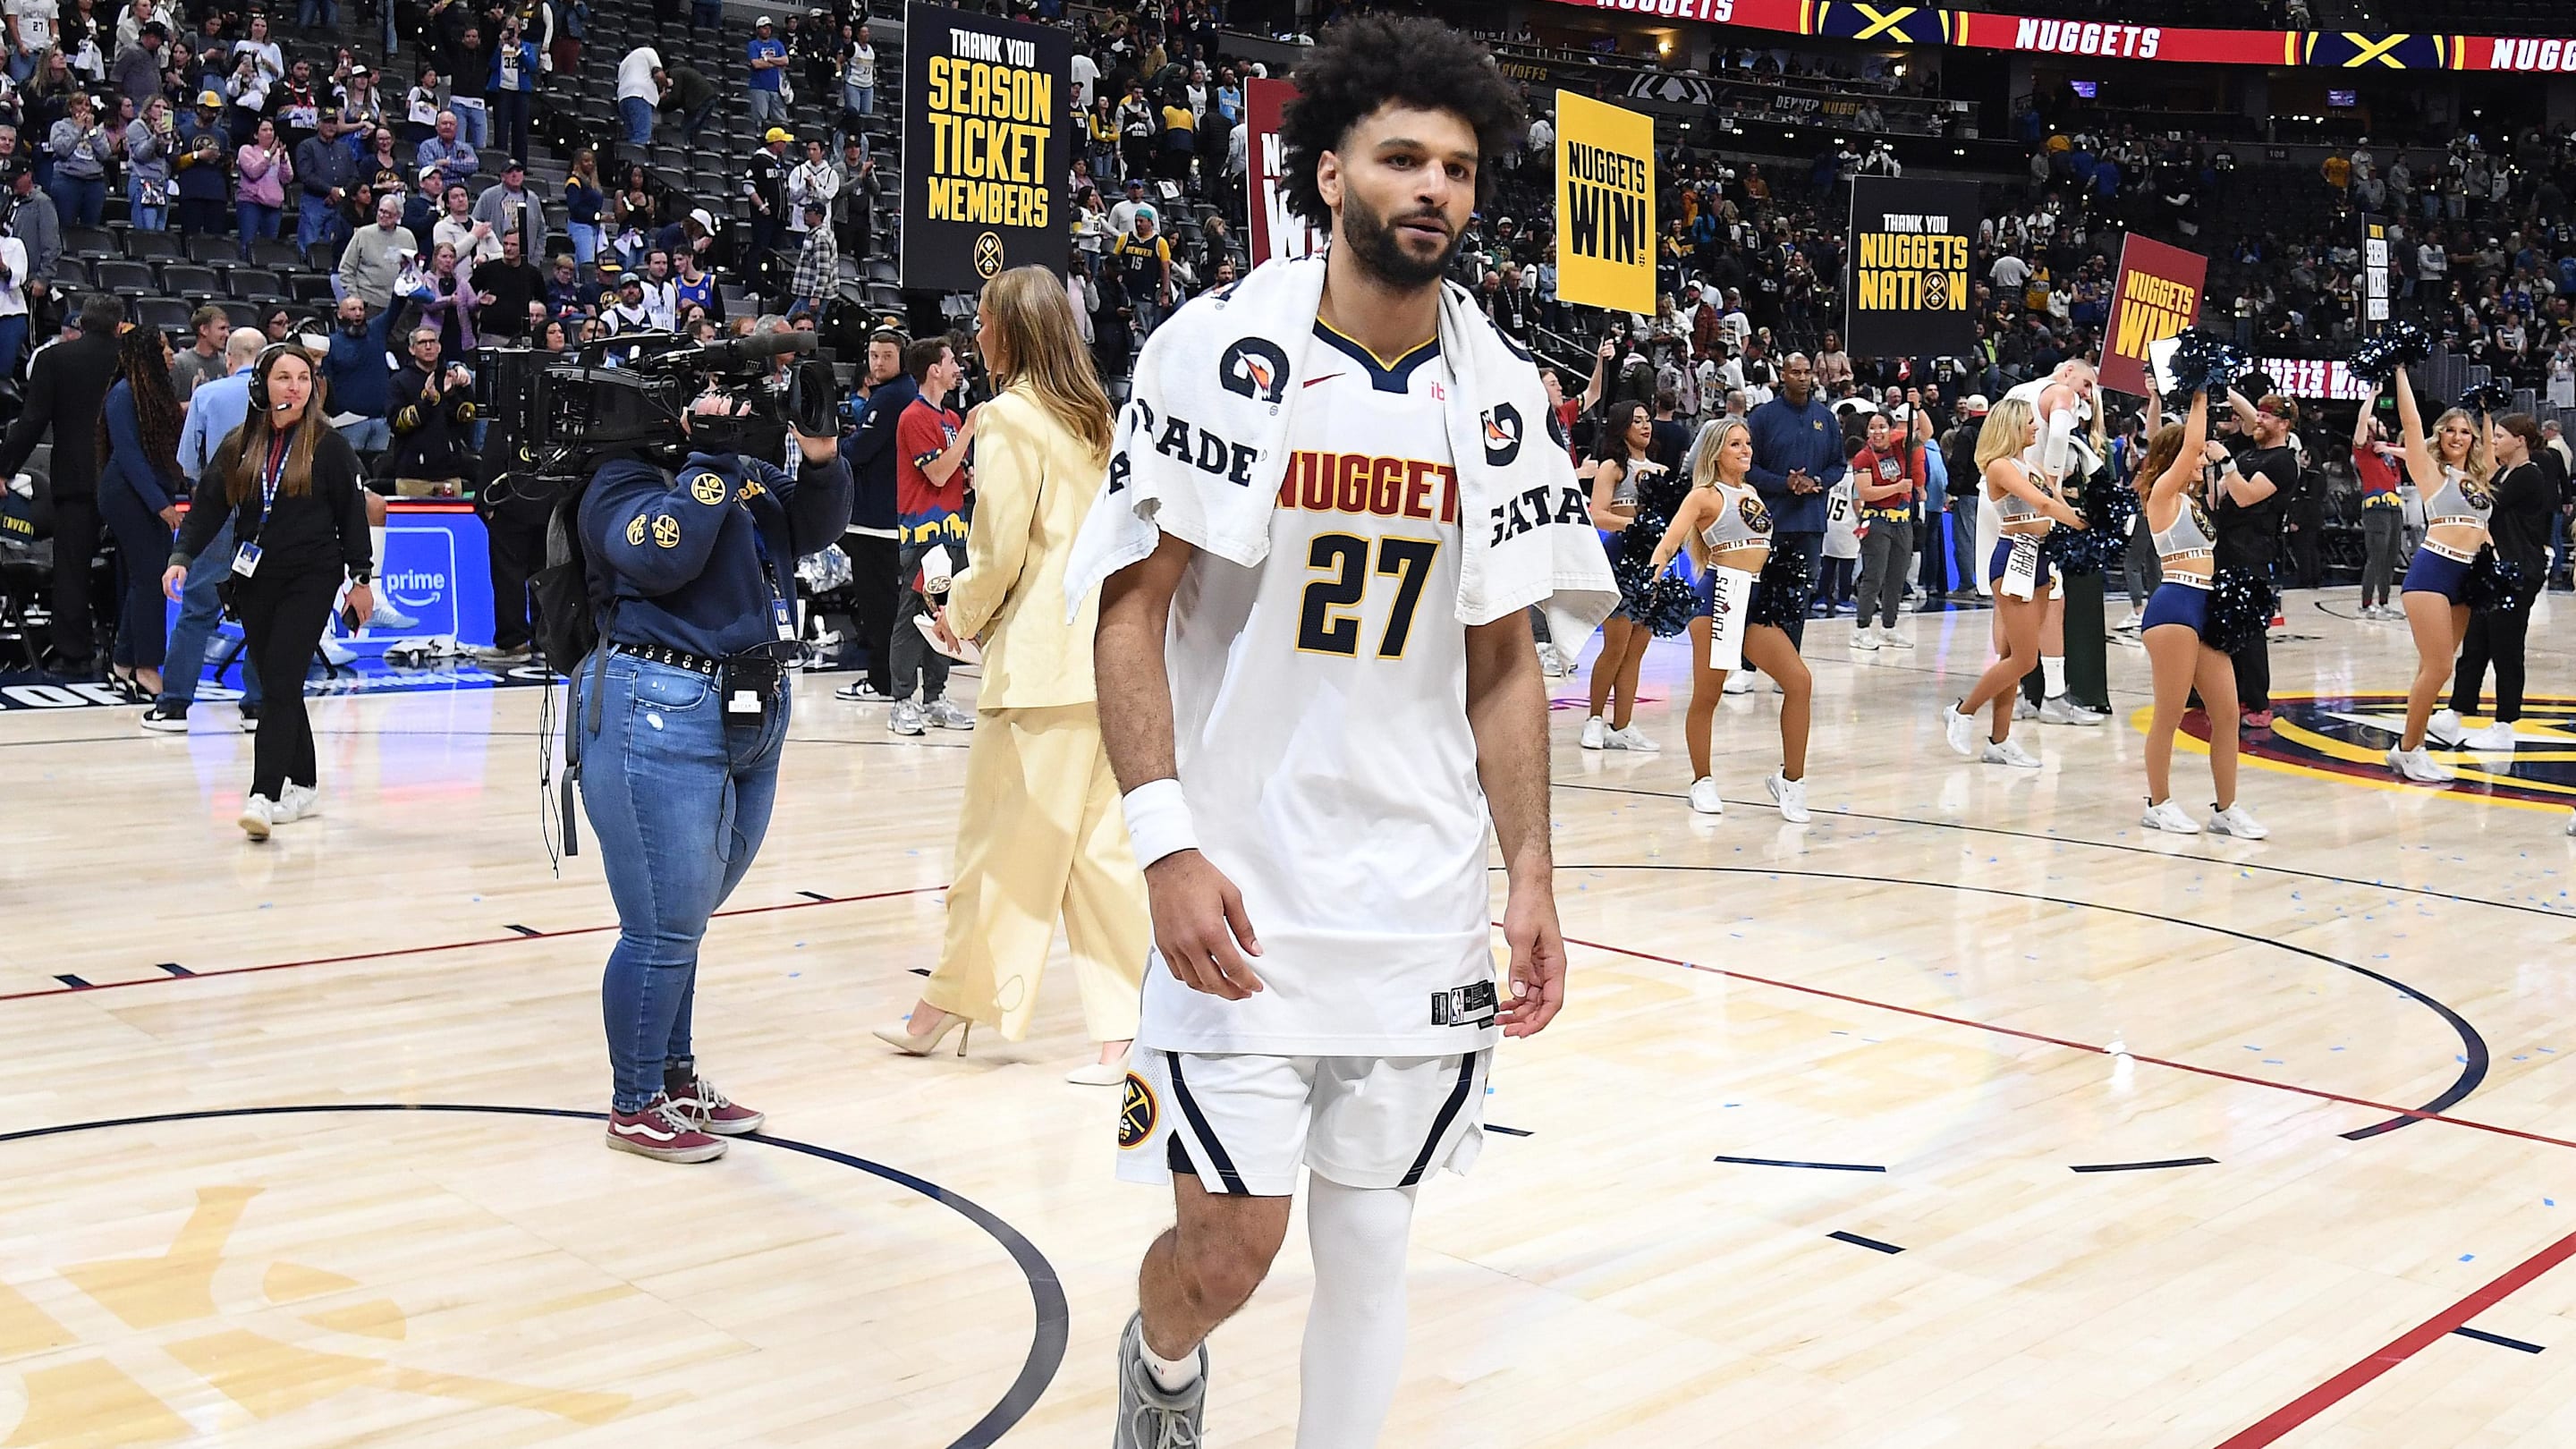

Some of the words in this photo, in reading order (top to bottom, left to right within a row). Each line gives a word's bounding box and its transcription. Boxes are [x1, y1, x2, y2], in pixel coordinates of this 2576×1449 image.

[950, 28, 1003, 63] THANK
[1005, 38, 1035, 68] YOU
[2014, 18, 2161, 59] NUGGETS
[2489, 38, 2576, 72] NUGG
[928, 55, 1052, 125] SEASON
[1496, 64, 1547, 80] AYOFFS
[928, 112, 1051, 185] TICKET
[1568, 140, 1646, 194] NUGGETS
[928, 176, 1048, 228] MEMBERS
[1568, 181, 1646, 267] WIN!
[1883, 214, 1923, 233] THANK
[1925, 216, 1948, 233] YOU
[1125, 245, 1153, 258] DENVER
[1131, 255, 1144, 270] 15
[1860, 233, 1968, 269] NUGGETS
[2124, 269, 2195, 315] NUGGETS
[1431, 382, 1445, 401] ib
[1938, 370, 1952, 382] 27
[1273, 449, 1460, 526] NUGGET
[386, 569, 445, 594] prime
[1295, 530, 1443, 661] 27
